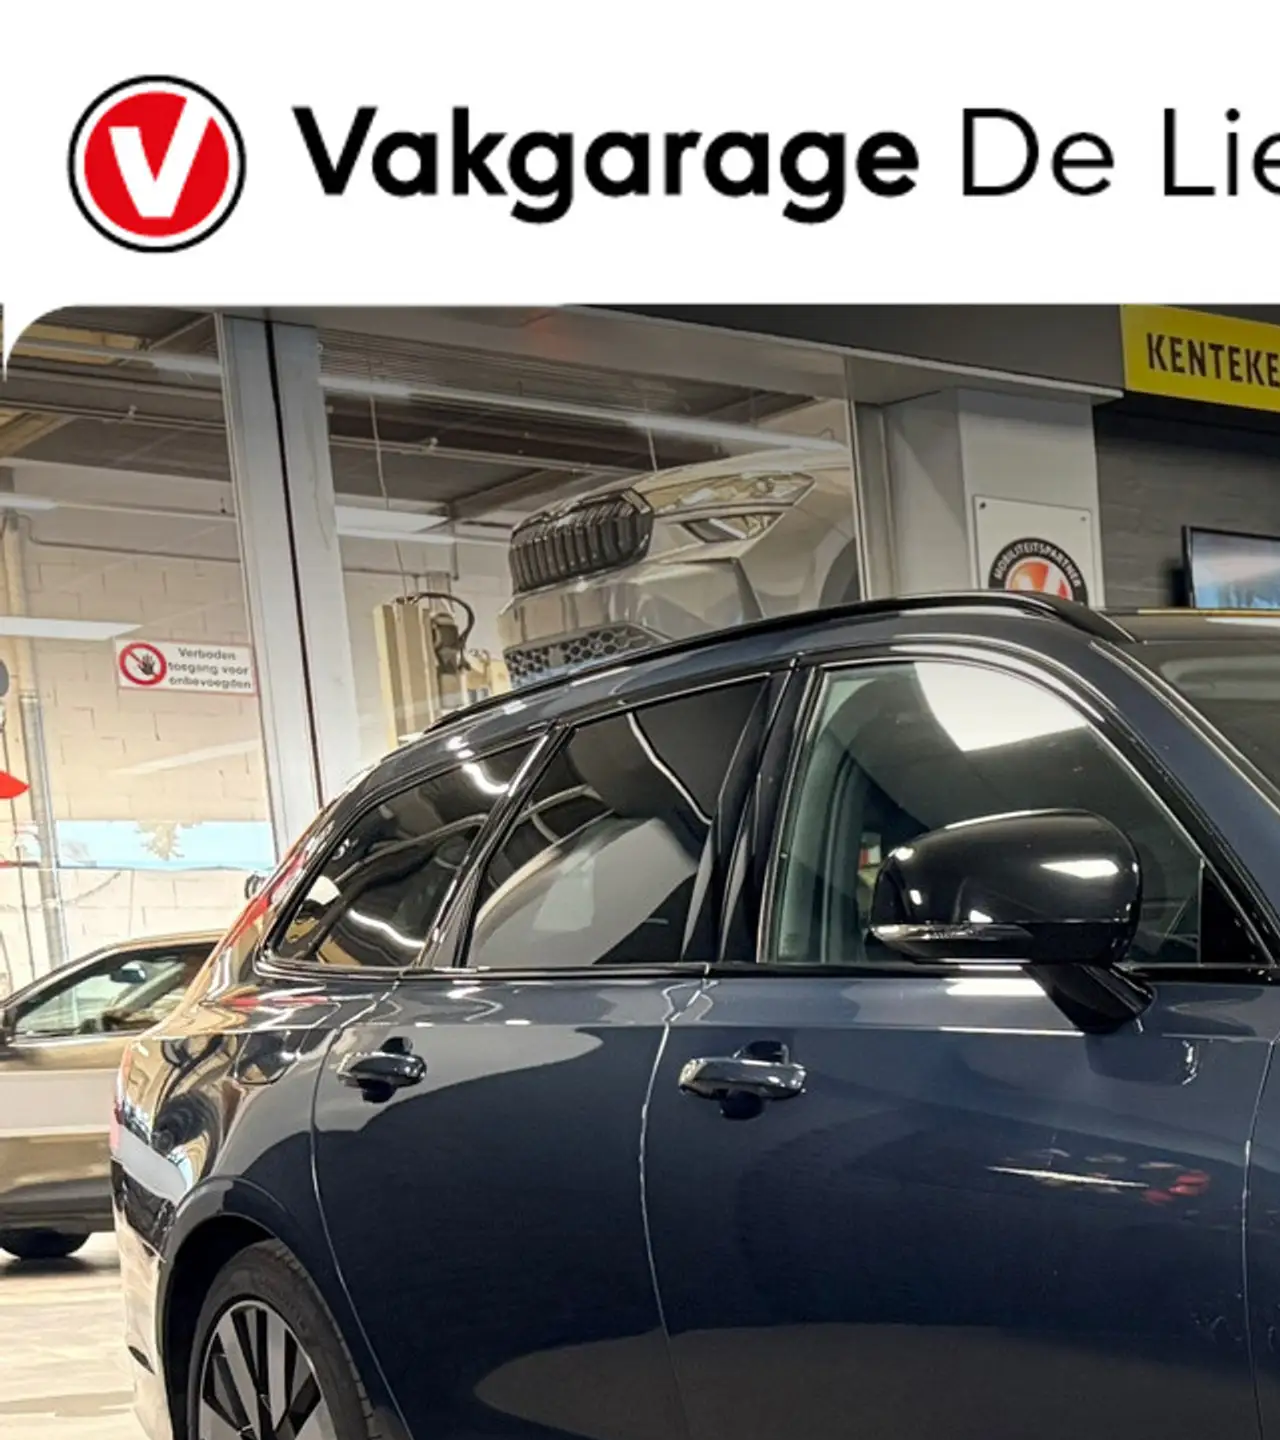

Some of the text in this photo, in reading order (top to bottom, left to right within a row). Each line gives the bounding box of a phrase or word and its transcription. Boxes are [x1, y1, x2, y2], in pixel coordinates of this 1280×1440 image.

[177, 647, 237, 661] Verboden
[167, 661, 249, 676] toegang voor
[168, 676, 252, 690] onbevoegden
